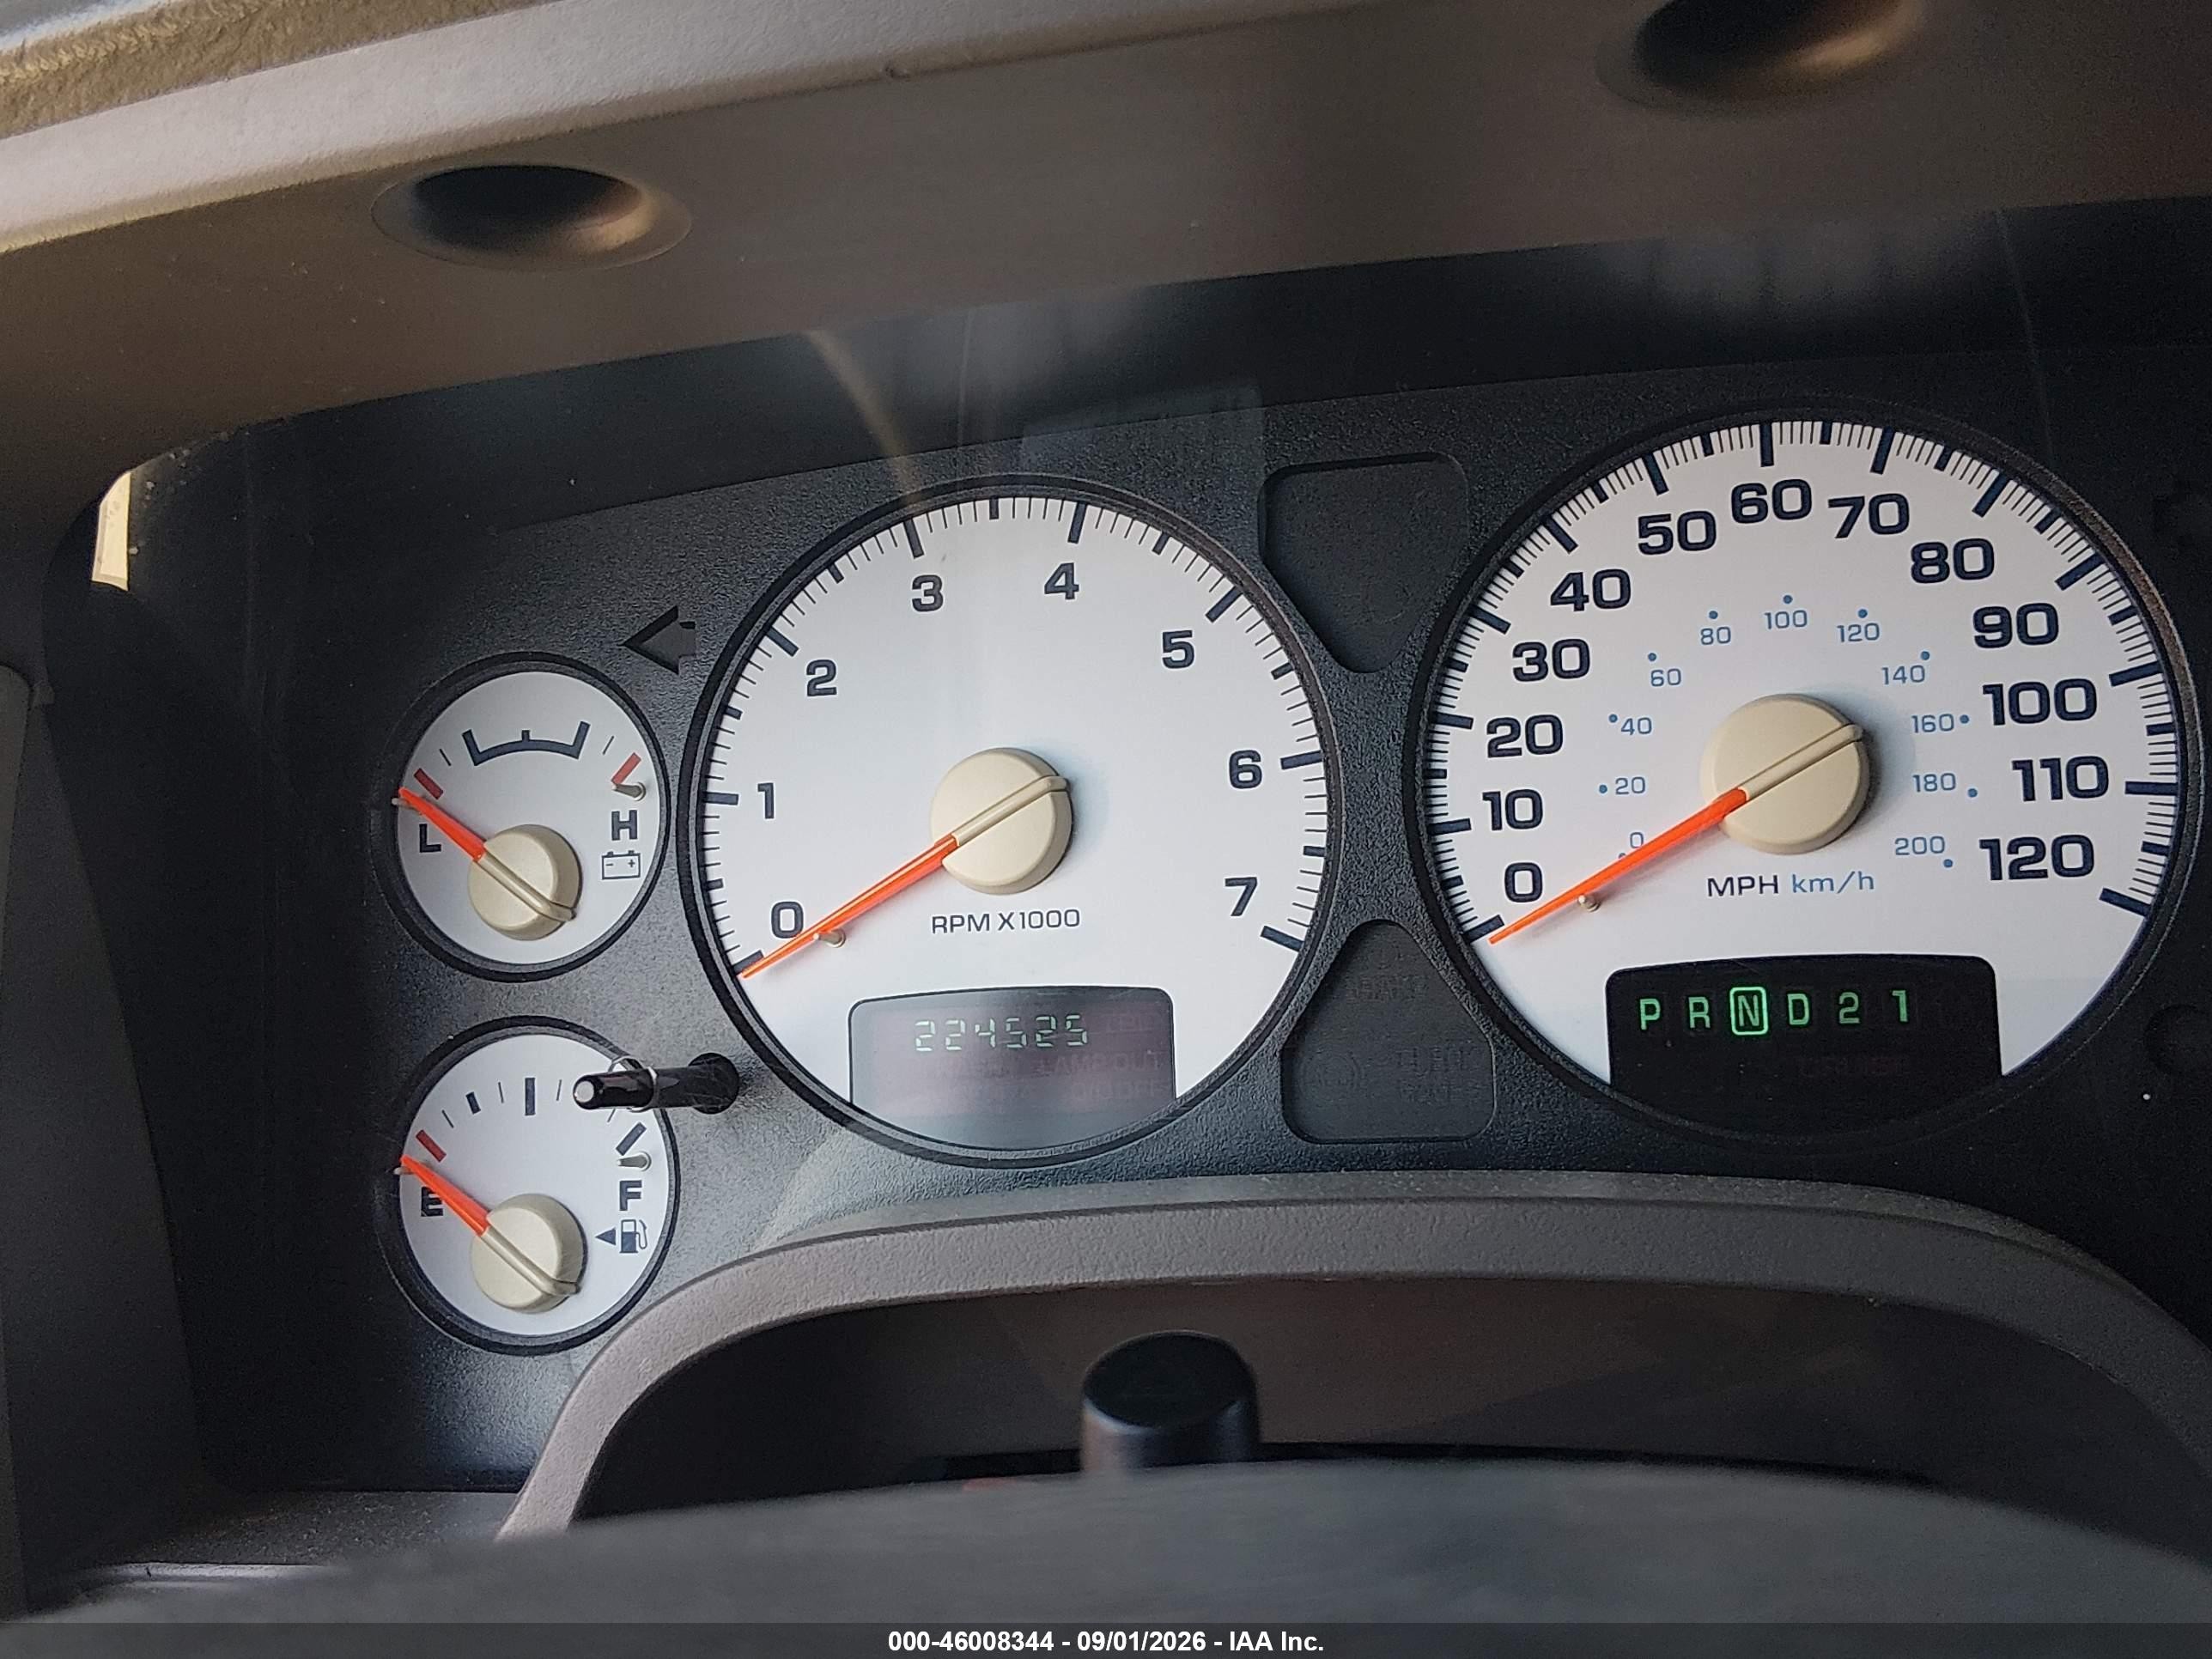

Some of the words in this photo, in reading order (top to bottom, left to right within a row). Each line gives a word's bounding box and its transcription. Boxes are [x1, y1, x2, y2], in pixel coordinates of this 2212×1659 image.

[1731, 479, 1812, 524] 60
[1828, 494, 1909, 538] 70
[1638, 511, 1717, 555] 50
[1911, 538, 1994, 583] 80
[912, 575, 943, 611] 3
[1044, 562, 1079, 599] 4
[1551, 569, 1631, 611] 40
[1701, 627, 1731, 645] 80
[1765, 611, 1807, 629] 100
[1838, 623, 1880, 642] 120
[1973, 603, 2058, 648] 90
[1163, 630, 1194, 668] 5
[1513, 639, 1589, 682] 30
[806, 659, 836, 696] 2
[1651, 669, 1681, 686] 60
[1882, 665, 1924, 684] 140
[1983, 678, 2097, 726] 100
[1487, 714, 1563, 757] 20
[1621, 718, 1651, 735] 40
[1912, 714, 1954, 732] 160
[1229, 750, 1261, 789] 6
[1616, 777, 1645, 794] 20
[1912, 773, 1955, 792] 180
[2012, 757, 2109, 801] 110
[758, 783, 774, 818] 1
[1483, 789, 1543, 830] 10
[419, 823, 441, 853] L
[611, 810, 637, 841] H
[1630, 832, 1644, 848] 0
[1895, 836, 1945, 855] 200
[1979, 835, 2094, 880] 120
[1225, 877, 1257, 916] 7
[1504, 863, 1542, 902] 0
[1708, 875, 1778, 896] MPH
[1793, 872, 1874, 893] km/h
[771, 902, 803, 939] 0
[933, 914, 989, 933] RPM
[999, 909, 1079, 930] X1000
[1640, 999, 1660, 1030] P
[1689, 997, 1710, 1028] R
[1738, 994, 1759, 1027] N
[1788, 994, 1808, 1024] D
[1840, 993, 1858, 1023] 2
[1893, 991, 1906, 1021] 1
[915, 1015, 1087, 1051] 224525
[421, 1187, 443, 1217] E
[620, 1180, 641, 1211] F
